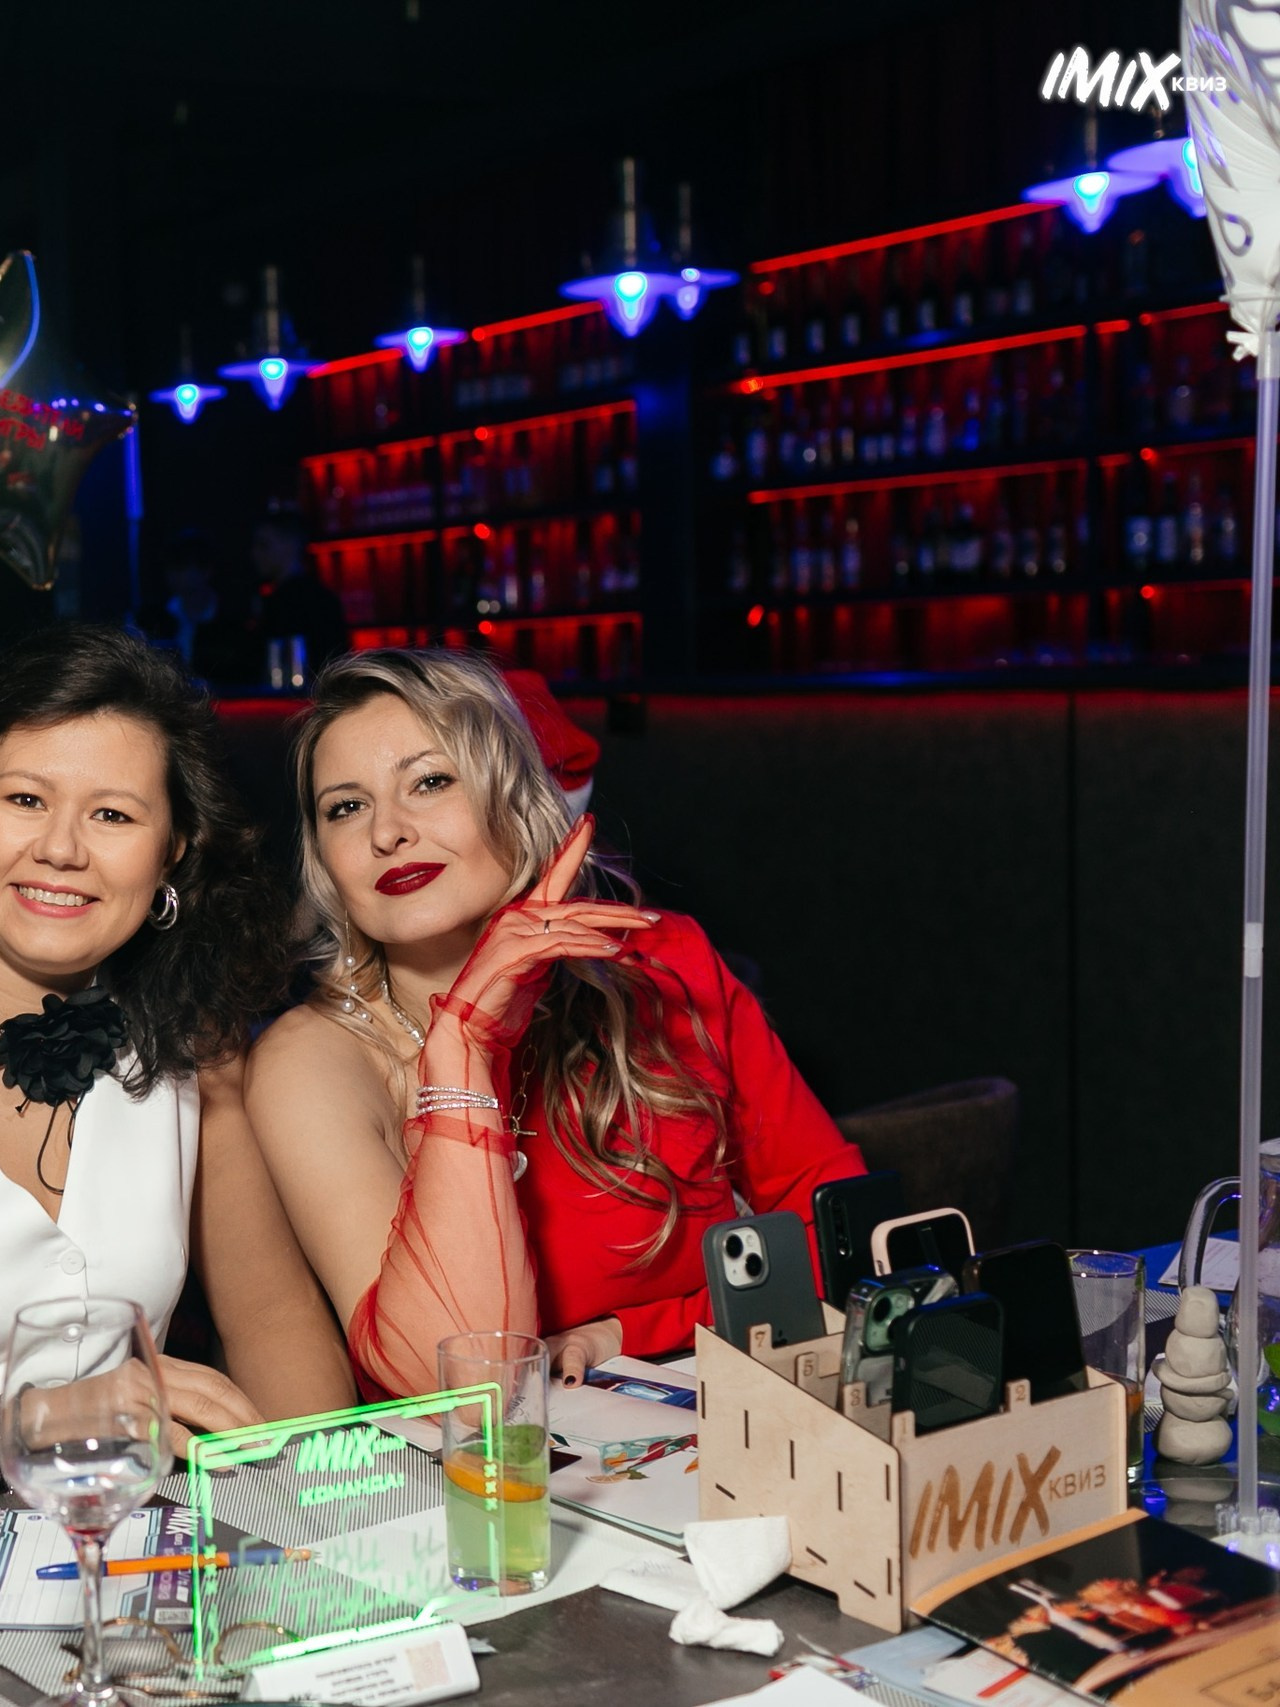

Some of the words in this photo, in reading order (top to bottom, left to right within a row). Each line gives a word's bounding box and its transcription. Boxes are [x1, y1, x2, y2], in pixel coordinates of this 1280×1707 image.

[754, 1330, 766, 1348] 7
[804, 1359, 813, 1377] 5
[1015, 1384, 1027, 1402] 2
[296, 1425, 380, 1474] IMIX
[909, 1445, 1062, 1559] IMIX
[1049, 1464, 1107, 1502] КВИЗ
